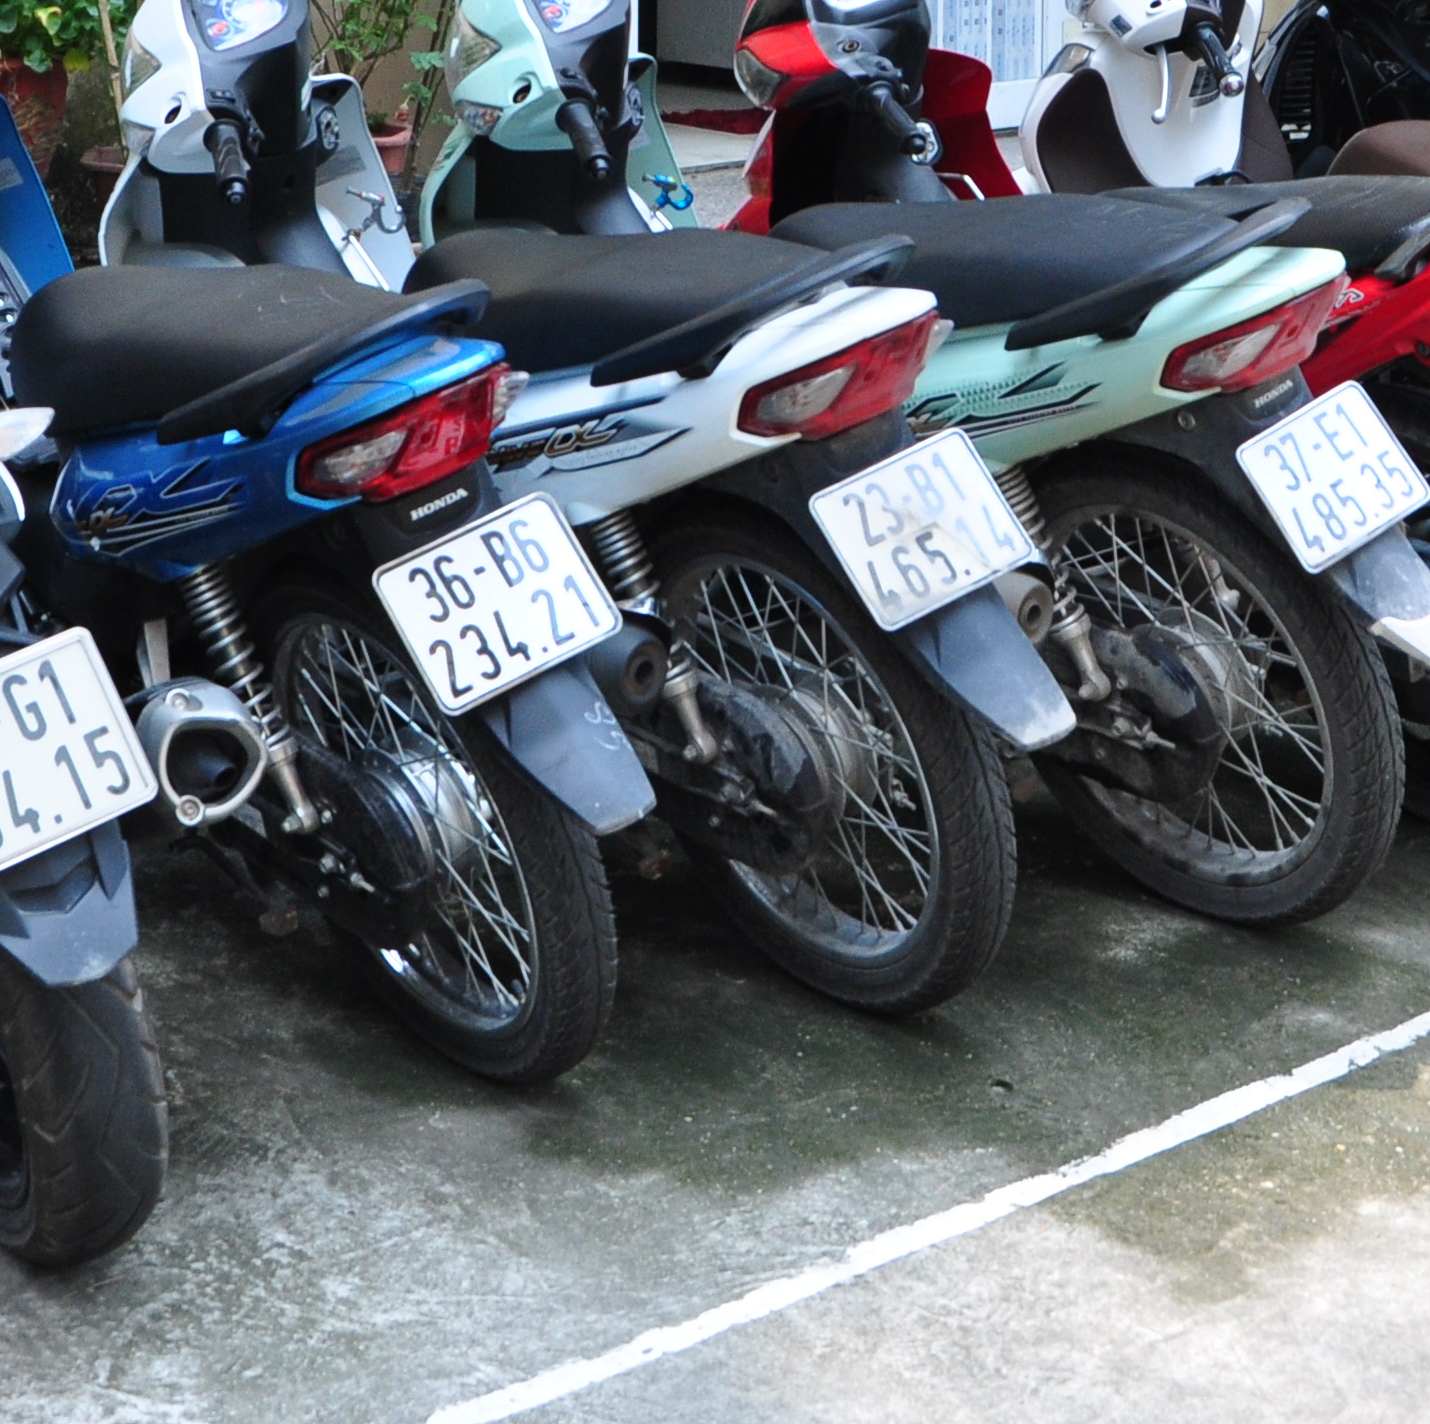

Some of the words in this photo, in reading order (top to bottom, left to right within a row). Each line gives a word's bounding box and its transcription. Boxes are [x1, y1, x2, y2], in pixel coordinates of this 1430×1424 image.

[1253, 379, 1294, 409] HONDA
[1264, 403, 1369, 491] 37-E1
[410, 488, 468, 522] HONDA
[843, 452, 966, 547] 23-B1
[1292, 450, 1414, 553] 485.35
[409, 519, 550, 623] 36-B6
[867, 504, 1016, 611] 465.14
[429, 574, 600, 698] 234.21
